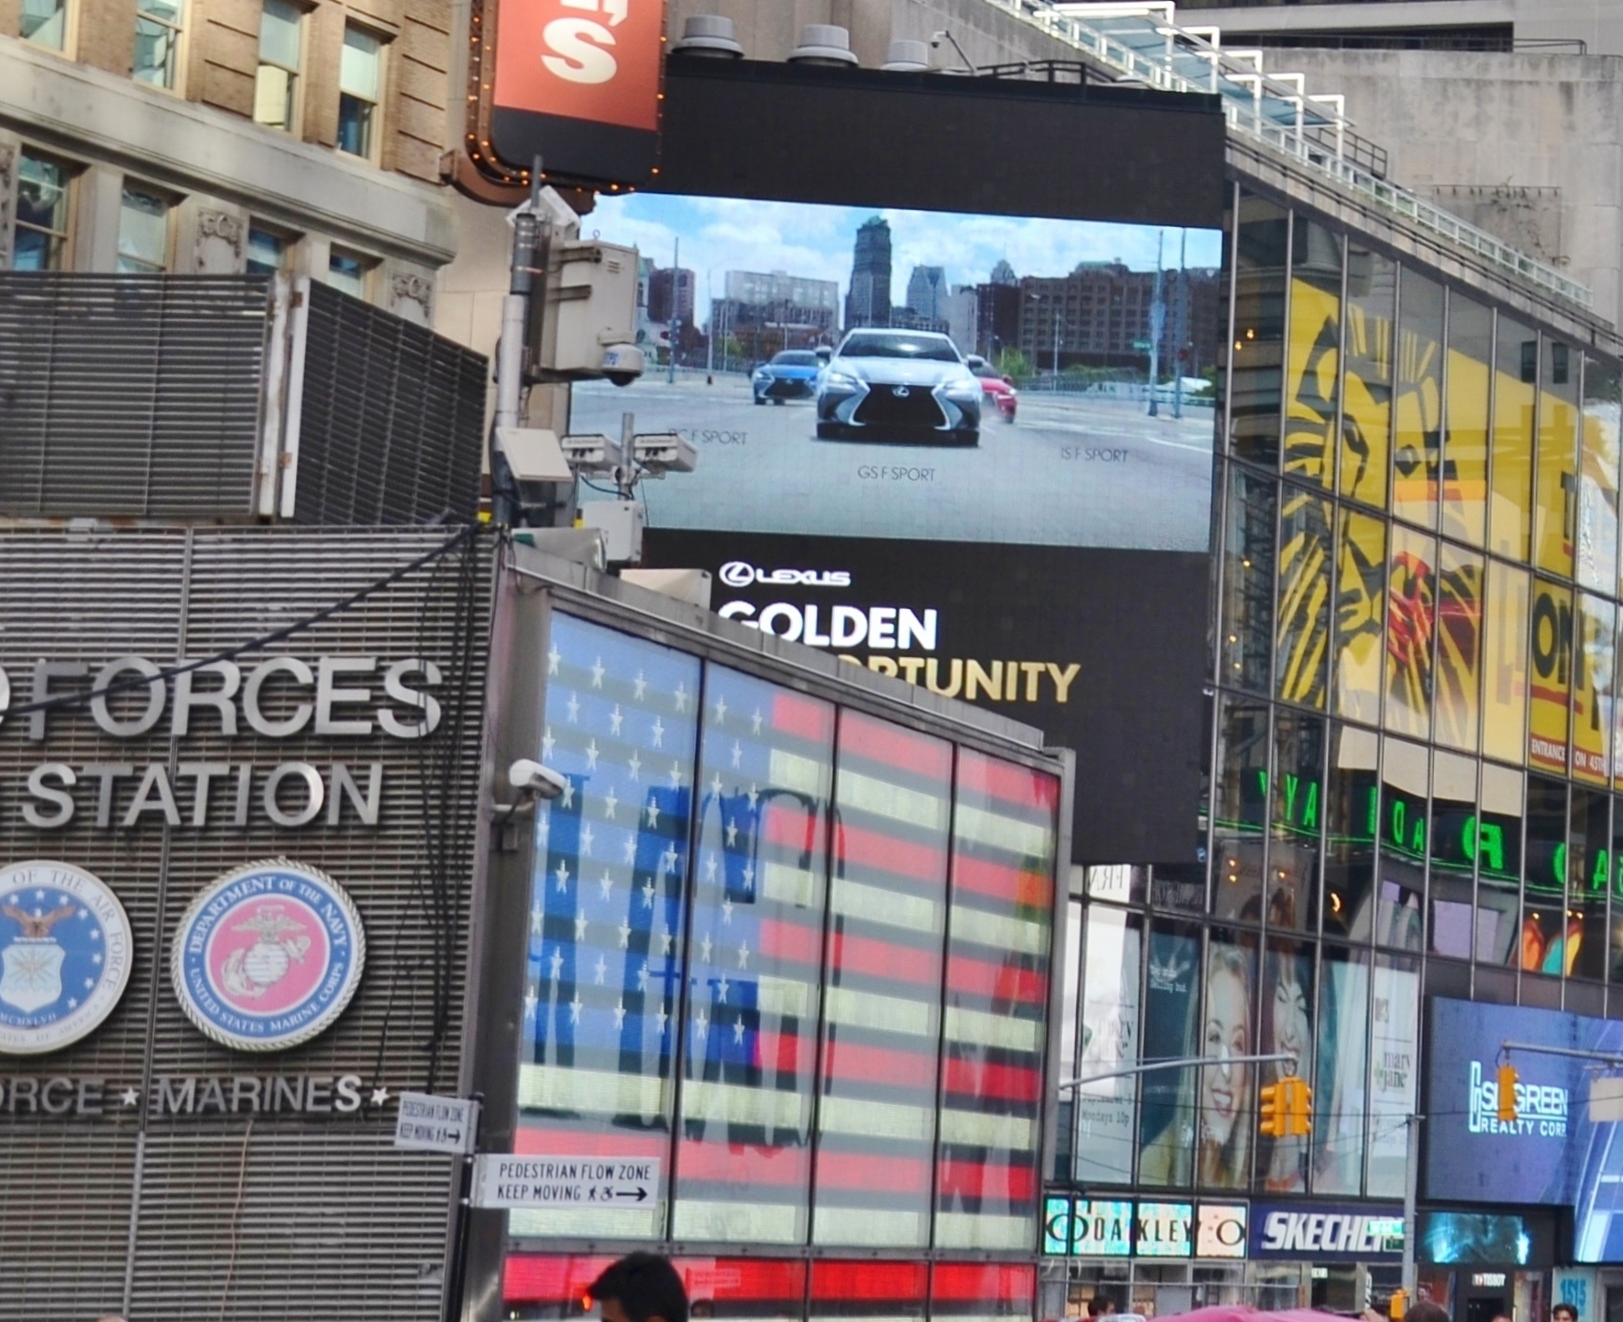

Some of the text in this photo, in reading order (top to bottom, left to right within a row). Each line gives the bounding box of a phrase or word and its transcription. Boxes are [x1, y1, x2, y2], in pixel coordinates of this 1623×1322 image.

[1084, 449, 1128, 464] SPORT
[857, 465, 935, 482] GS SPORT
[755, 568, 851, 587] LEXUS
[718, 600, 938, 650] GOLDEN
[29, 656, 442, 740] FORCES
[1531, 738, 1566, 761] ENTRANCE
[22, 762, 383, 827] STATION
[189, 876, 348, 955] DEPARTMENT OF THE NAVY
[13, 869, 125, 992] OF THE AIR FORCE
[190, 962, 345, 1033] UNITED STATES MARINE CORPS
[156, 1074, 363, 1114] MARINES
[1513, 1083, 1568, 1115] GREEN
[1481, 1120, 1534, 1136] REALTY
[499, 1162, 652, 1179] PEDESTRIAN FLOW ZONE
[498, 1184, 581, 1201] KEEP MOVING
[1093, 1219, 1199, 1244] OAKLEY
